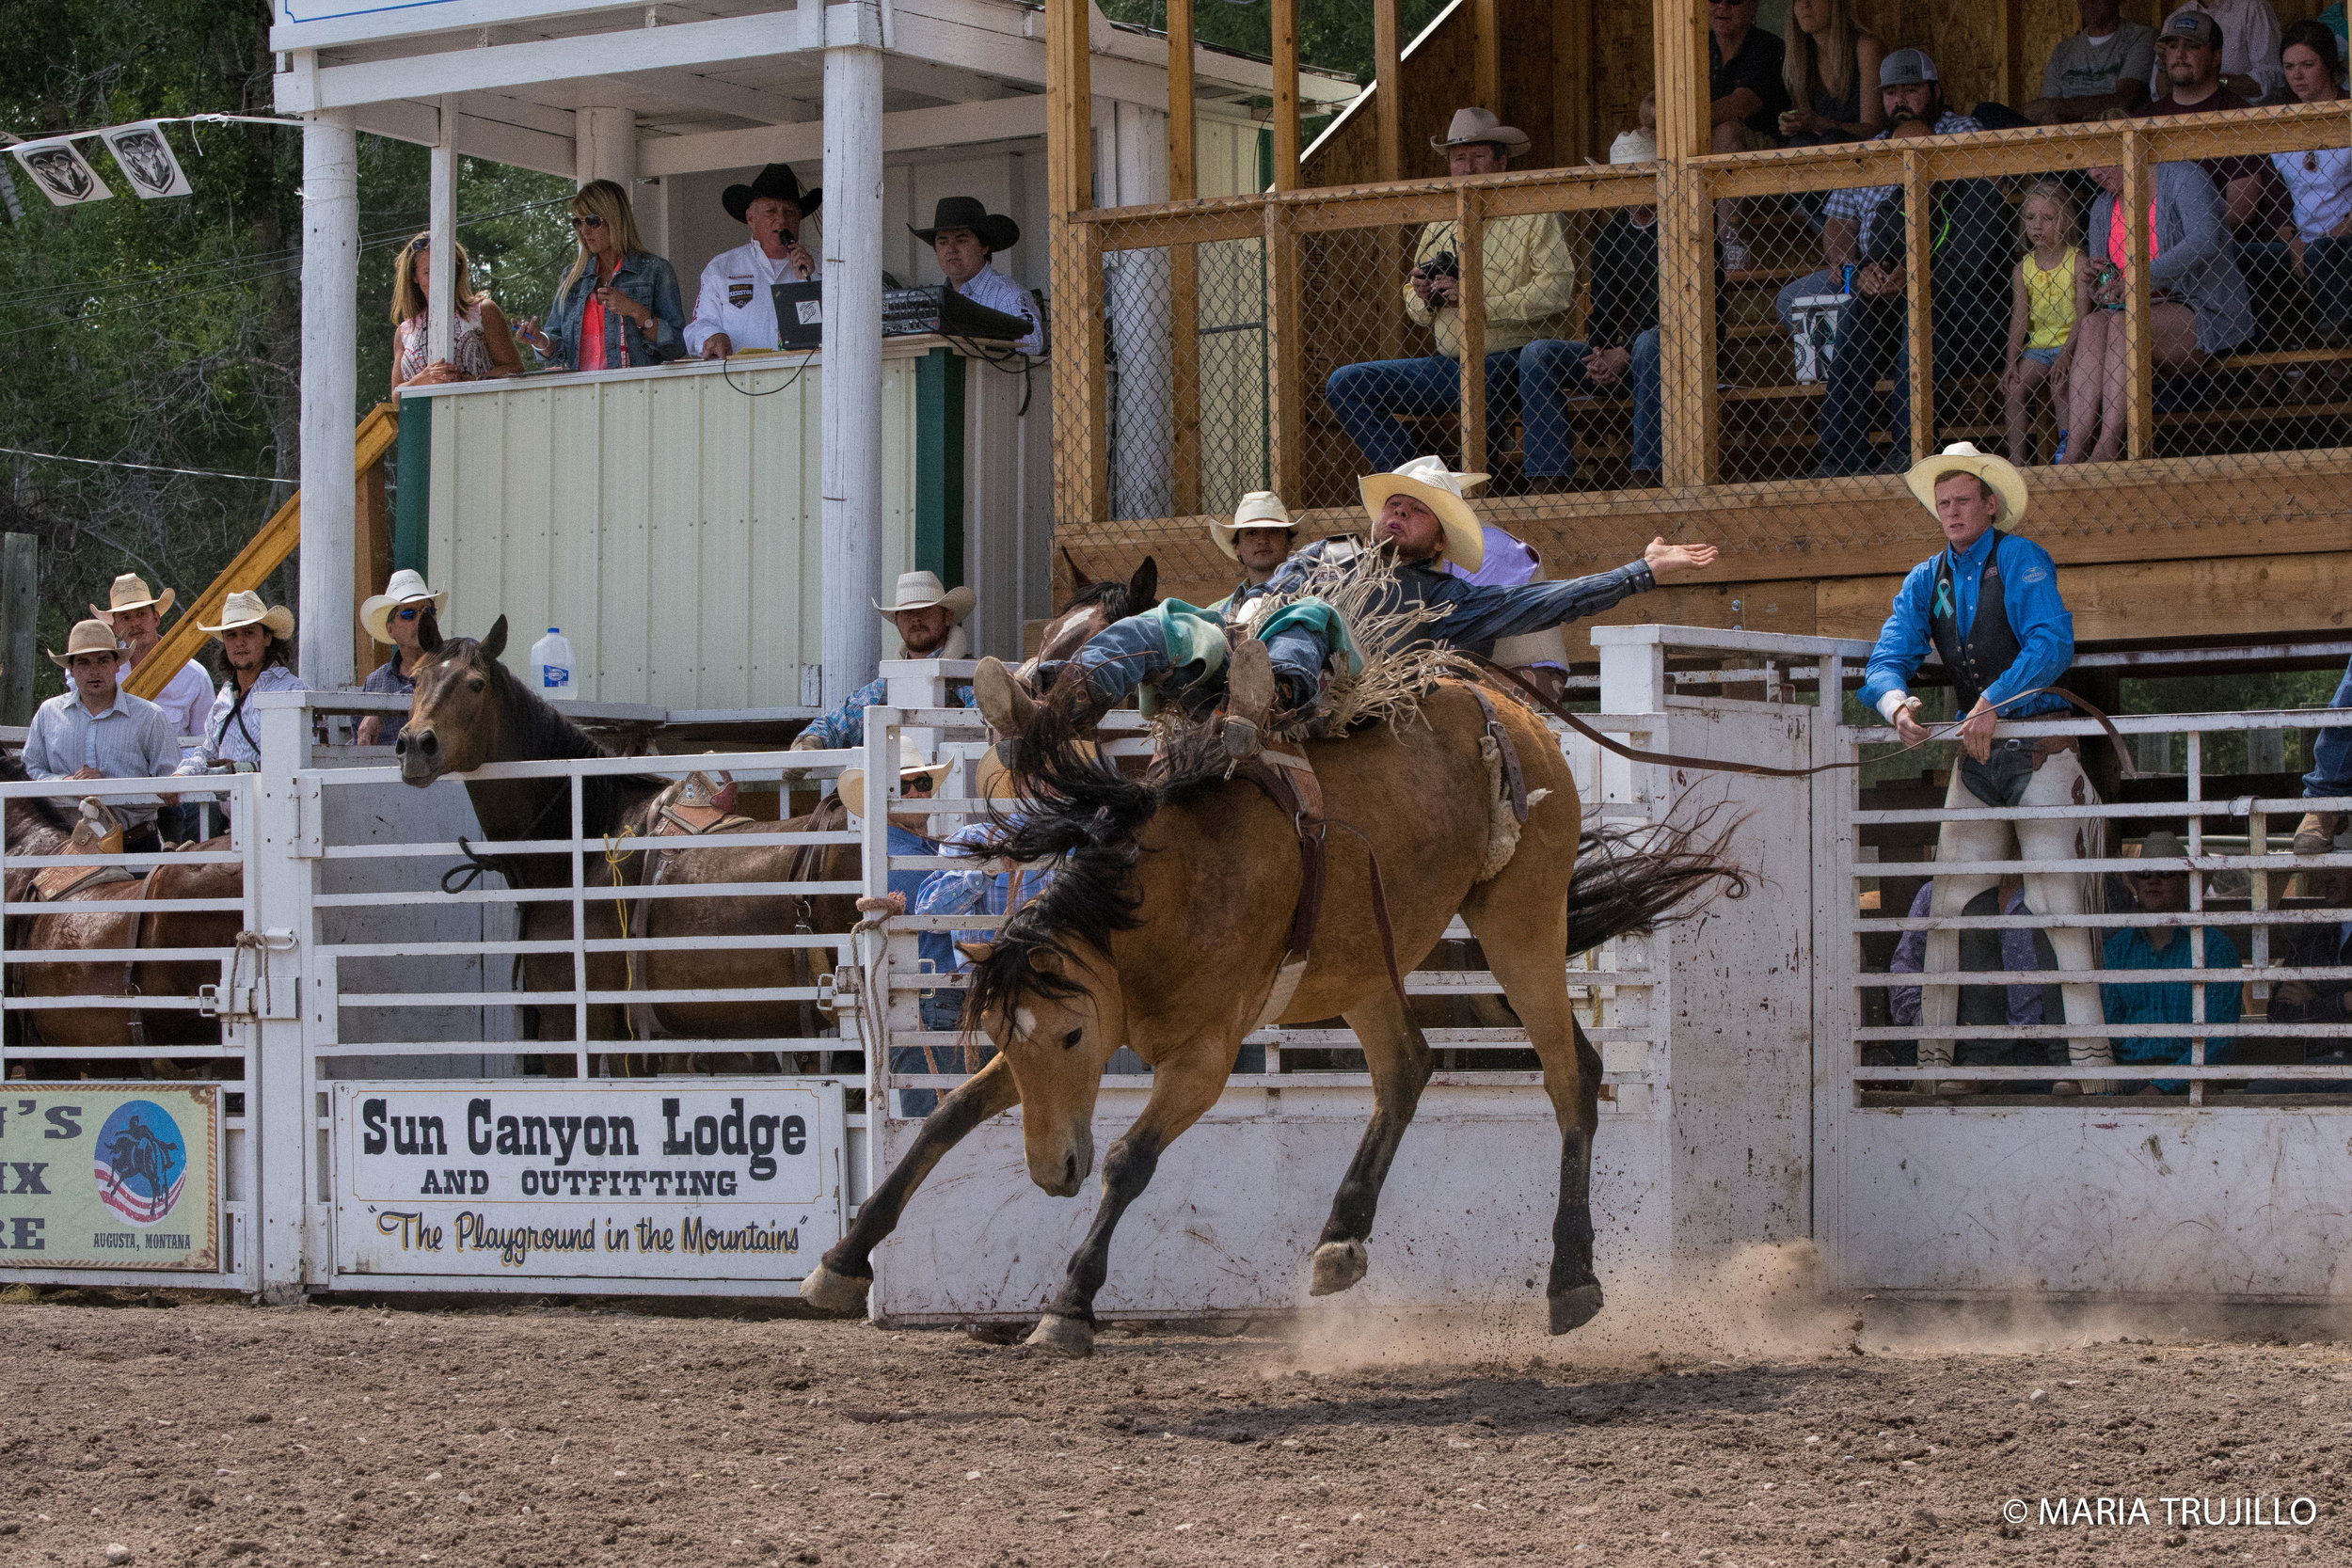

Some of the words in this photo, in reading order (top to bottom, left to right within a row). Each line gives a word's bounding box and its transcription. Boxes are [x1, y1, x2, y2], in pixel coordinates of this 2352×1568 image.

[0, 1100, 83, 1140] 'S
[362, 1098, 448, 1156] Sun
[468, 1098, 640, 1166] Canyon
[661, 1097, 807, 1181] Lodge
[420, 1168, 490, 1196] AND
[521, 1168, 739, 1197] OUTFITTING
[0, 1217, 45, 1249] E
[92, 1232, 140, 1252] AUGUSTA,
[145, 1233, 191, 1249] MONTANA
[454, 1211, 596, 1267] Playground
[604, 1216, 629, 1253] in
[634, 1216, 675, 1254] the
